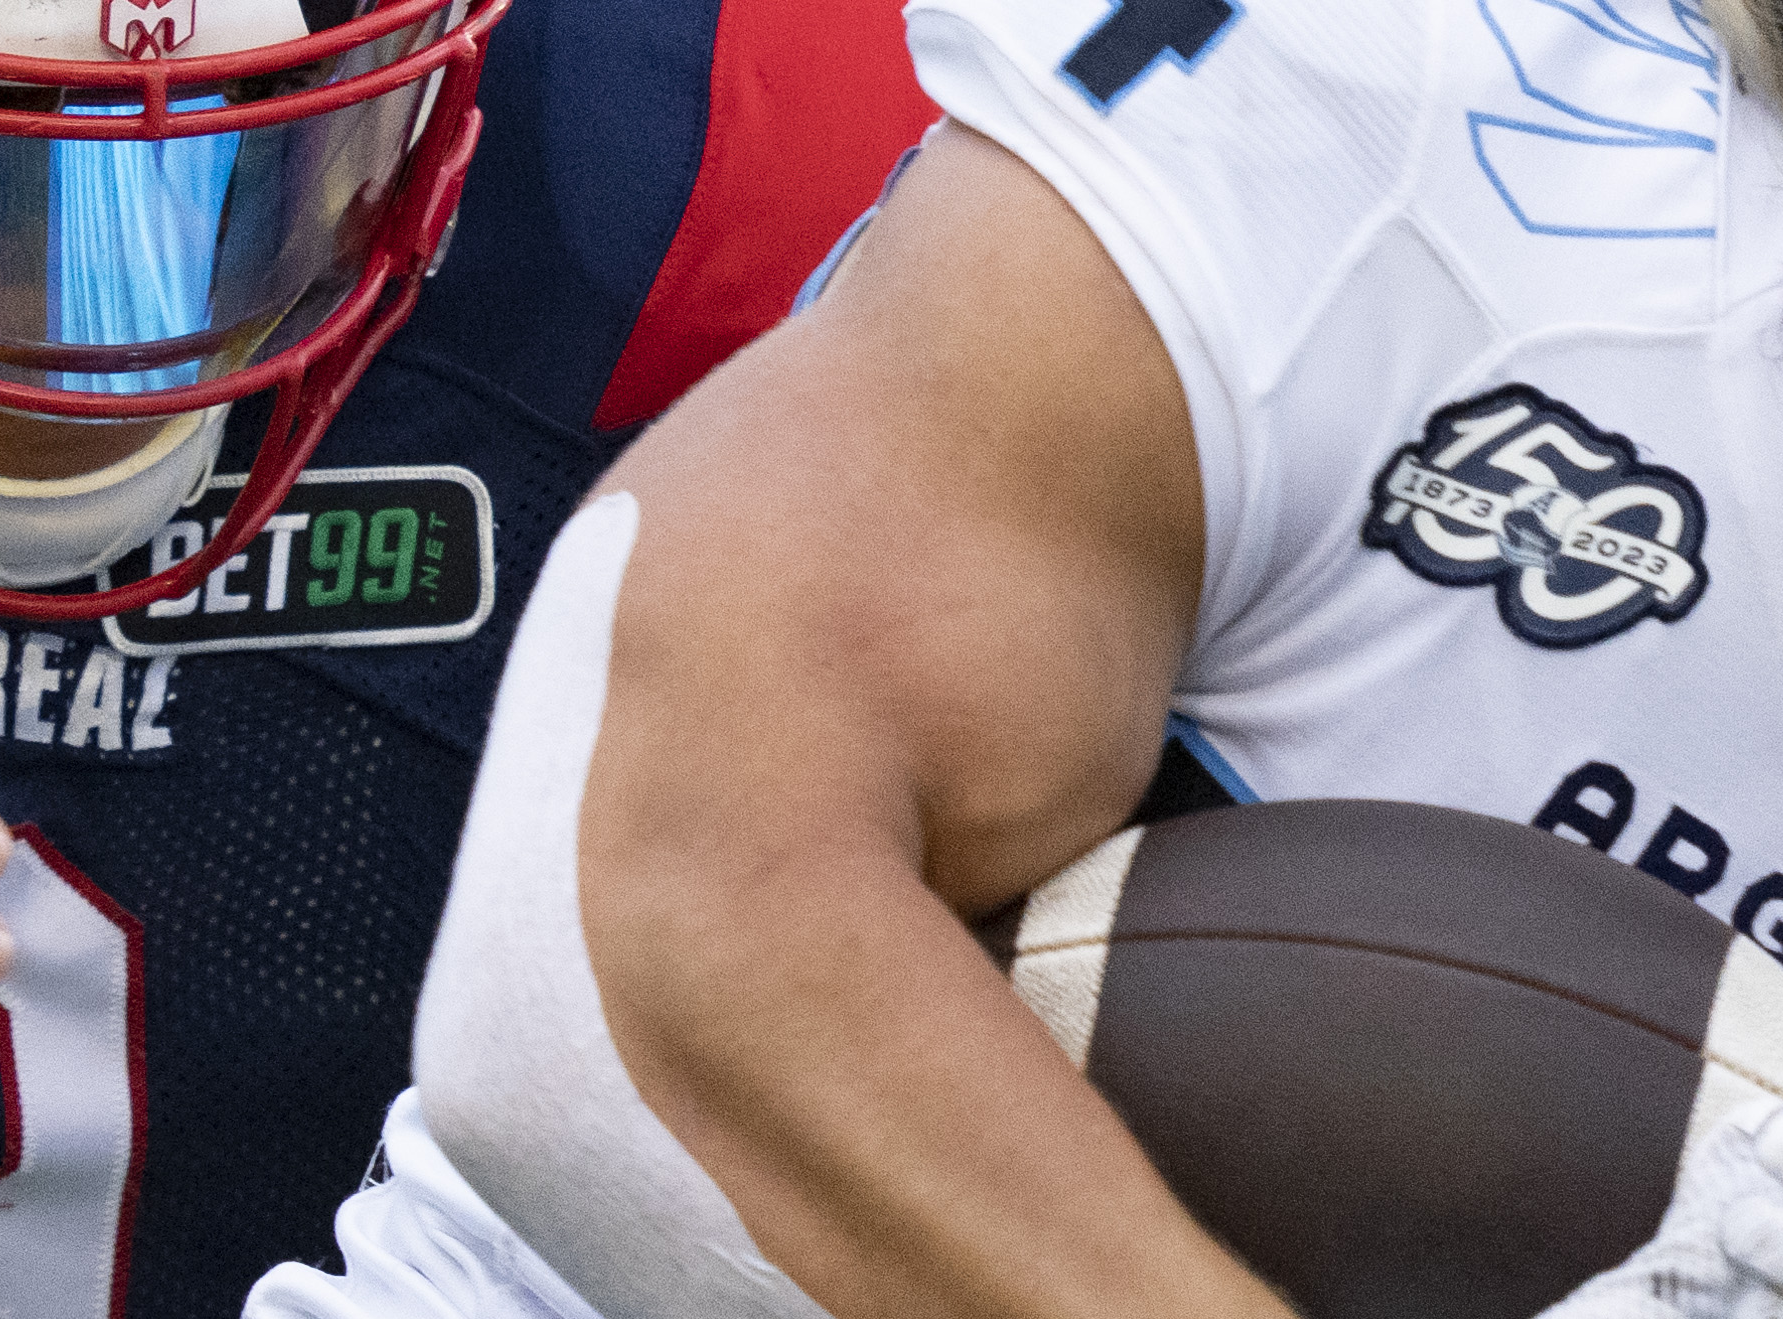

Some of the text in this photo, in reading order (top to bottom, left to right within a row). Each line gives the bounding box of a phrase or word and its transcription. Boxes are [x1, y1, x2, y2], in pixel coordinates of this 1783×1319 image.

[1383, 401, 1685, 622] 150
[1401, 469, 1497, 519] 1873
[146, 507, 449, 618] BET99 .NET
[1571, 529, 1670, 578] 2023
